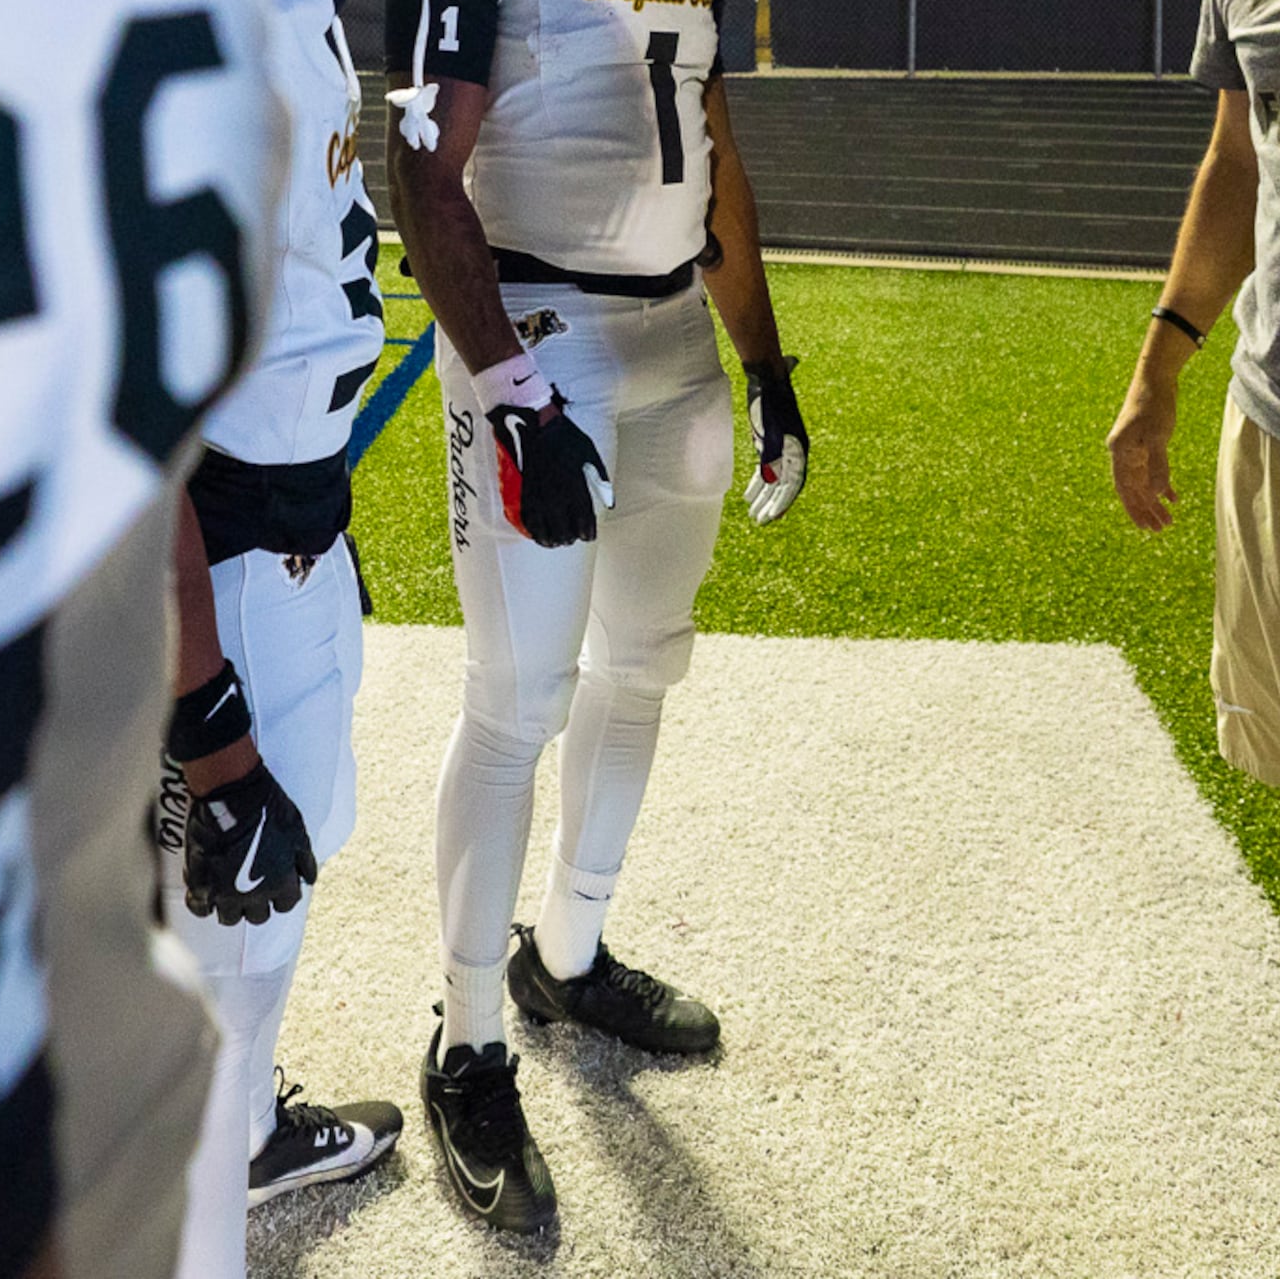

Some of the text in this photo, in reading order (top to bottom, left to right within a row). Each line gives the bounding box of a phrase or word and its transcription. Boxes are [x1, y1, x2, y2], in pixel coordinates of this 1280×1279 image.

[438, 5, 460, 53] 1
[644, 30, 685, 186] 1
[448, 400, 478, 554] Packers
